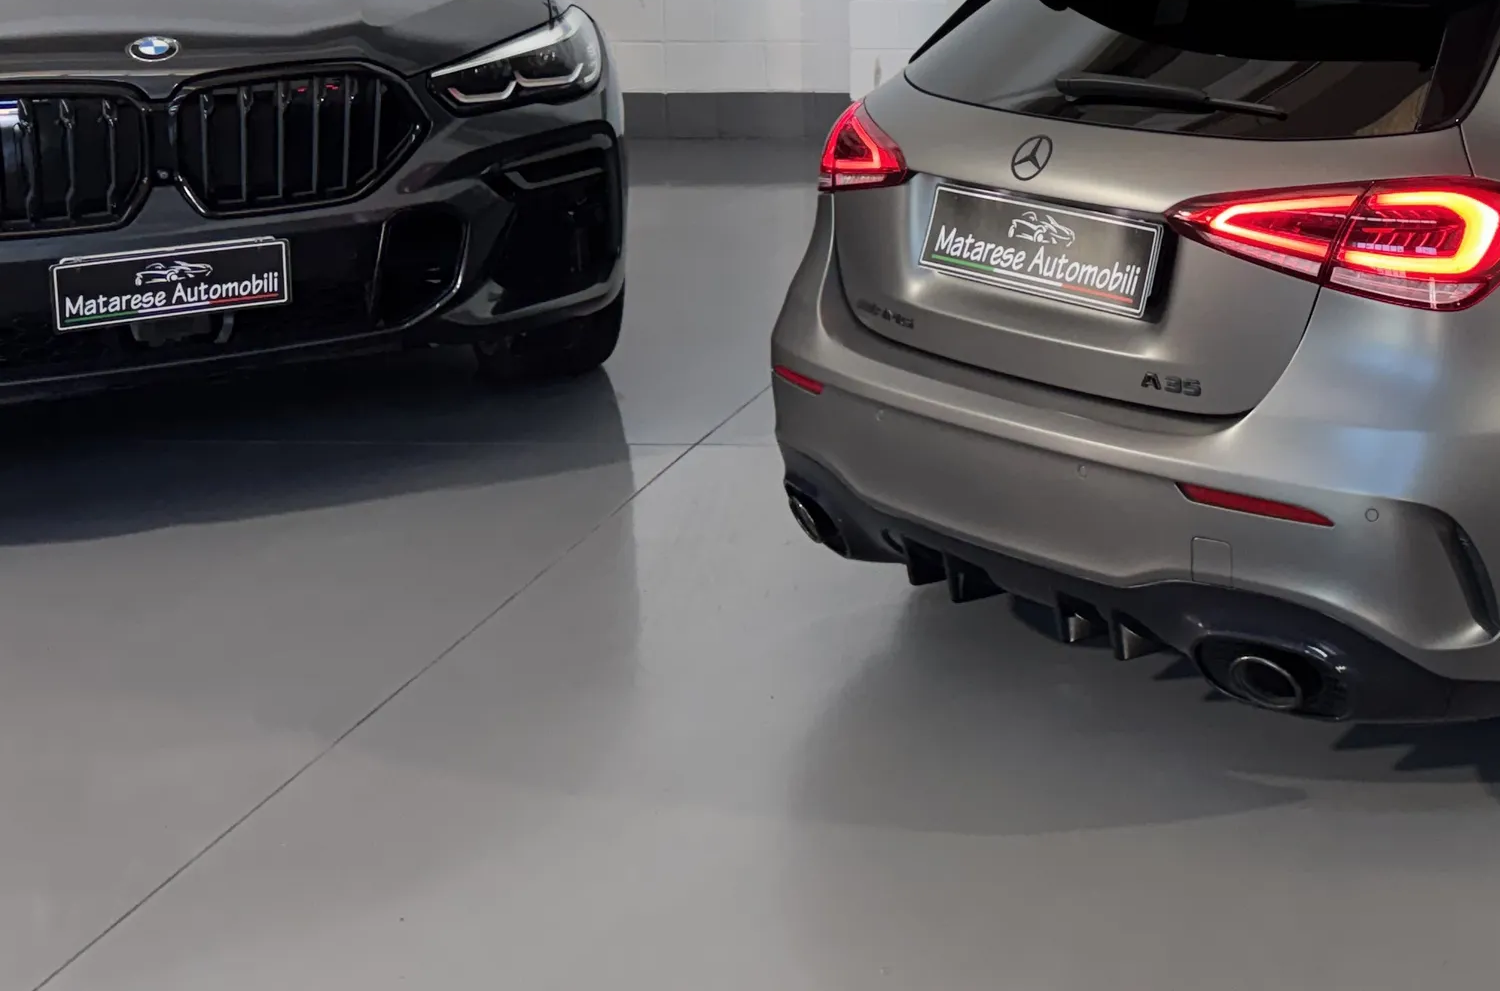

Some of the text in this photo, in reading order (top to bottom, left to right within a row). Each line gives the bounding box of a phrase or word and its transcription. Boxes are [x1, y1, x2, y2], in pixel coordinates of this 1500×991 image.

[934, 225, 1141, 296] Matarese Automobili
[65, 272, 279, 318] Matarese Automobili
